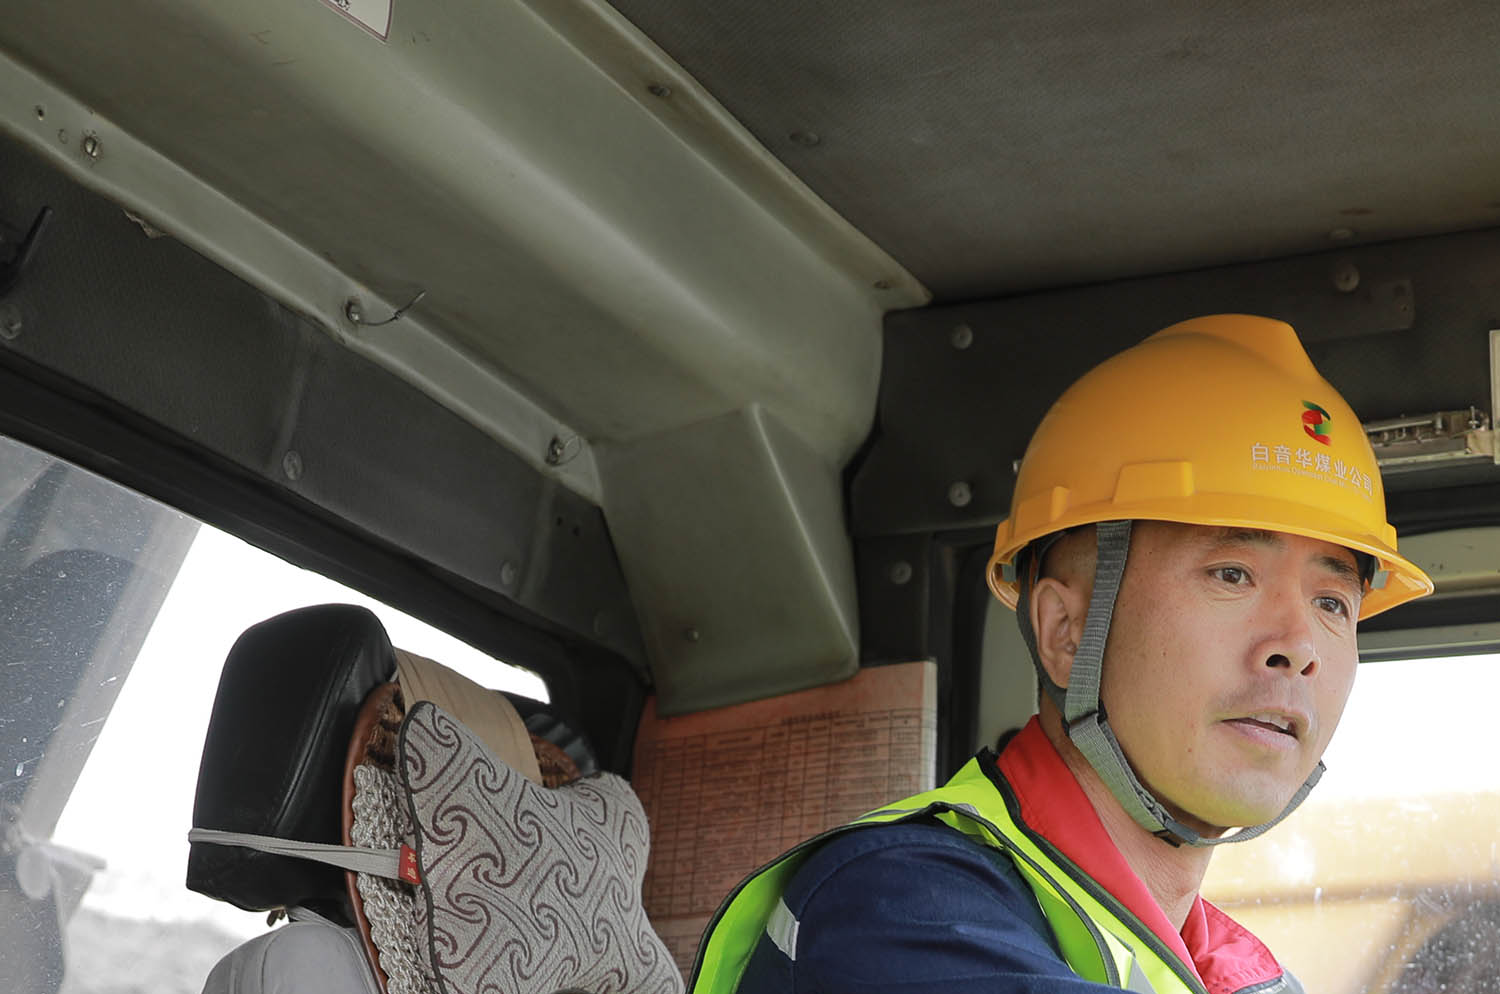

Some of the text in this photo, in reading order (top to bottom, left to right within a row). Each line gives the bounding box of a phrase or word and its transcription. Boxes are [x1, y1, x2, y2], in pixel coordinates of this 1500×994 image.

[1251, 442, 1373, 497] 白音华煤业公司
